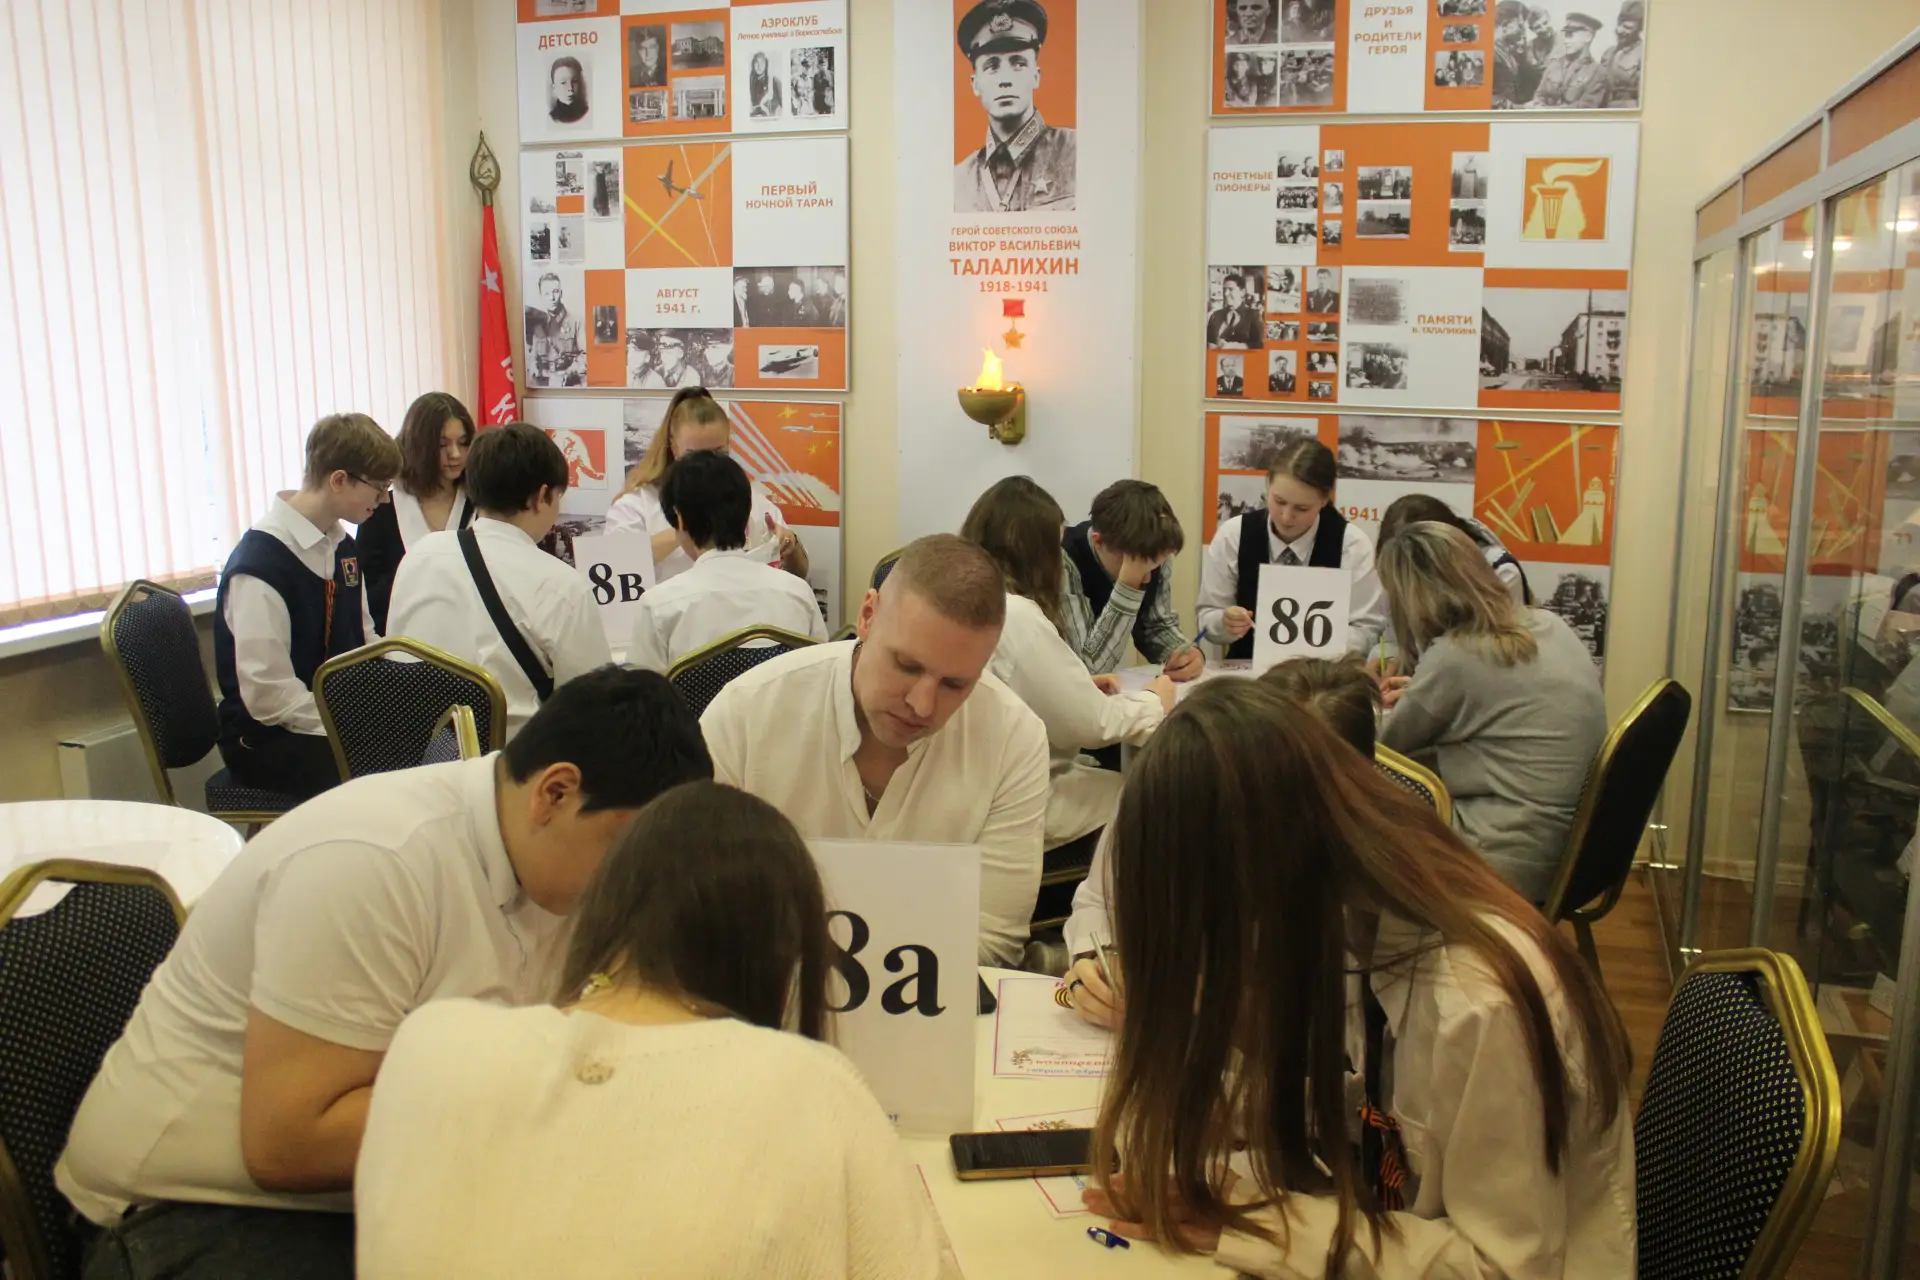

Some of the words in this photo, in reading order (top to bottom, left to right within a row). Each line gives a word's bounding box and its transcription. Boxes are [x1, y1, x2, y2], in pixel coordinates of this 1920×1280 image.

[1364, 5, 1414, 17] ДРУЗЬЯ
[760, 15, 819, 28] АЭРОКЛУБ
[1384, 19, 1393, 28] И
[538, 31, 599, 50] ДЕТСТВО
[1354, 31, 1422, 43] РОДИТЕЛИ
[1368, 44, 1408, 55] ГЕРОЯ
[1212, 171, 1273, 181] ПОЧЕТНЫЕ
[760, 180, 819, 196] ПЕРВЫЙ
[1215, 183, 1271, 192] ПИОНЕРЫ
[745, 196, 793, 210] НОЧНОЙ
[797, 198, 834, 209] ТАРАН
[951, 225, 981, 236] ГЕРОЙ
[982, 226, 1042, 236] СОВЕТСКОГО
[1044, 225, 1078, 235] СОЮЗА
[949, 241, 996, 251] ВИКТОР
[1000, 240, 1081, 251] ВАСИЛЬЕВИЧ
[949, 257, 1079, 276] ТАЛАЛИХИН
[979, 281, 1049, 292] 1918-1941
[656, 287, 700, 299] АВГУСТ
[655, 303, 689, 314] 1941
[690, 305, 701, 314] г.
[1417, 314, 1473, 325] ПАМЯТИ
[1340, 506, 1380, 521] 1941
[588, 562, 646, 606] 8в
[1268, 597, 1335, 648] 8б
[824, 910, 946, 1017] 8а
